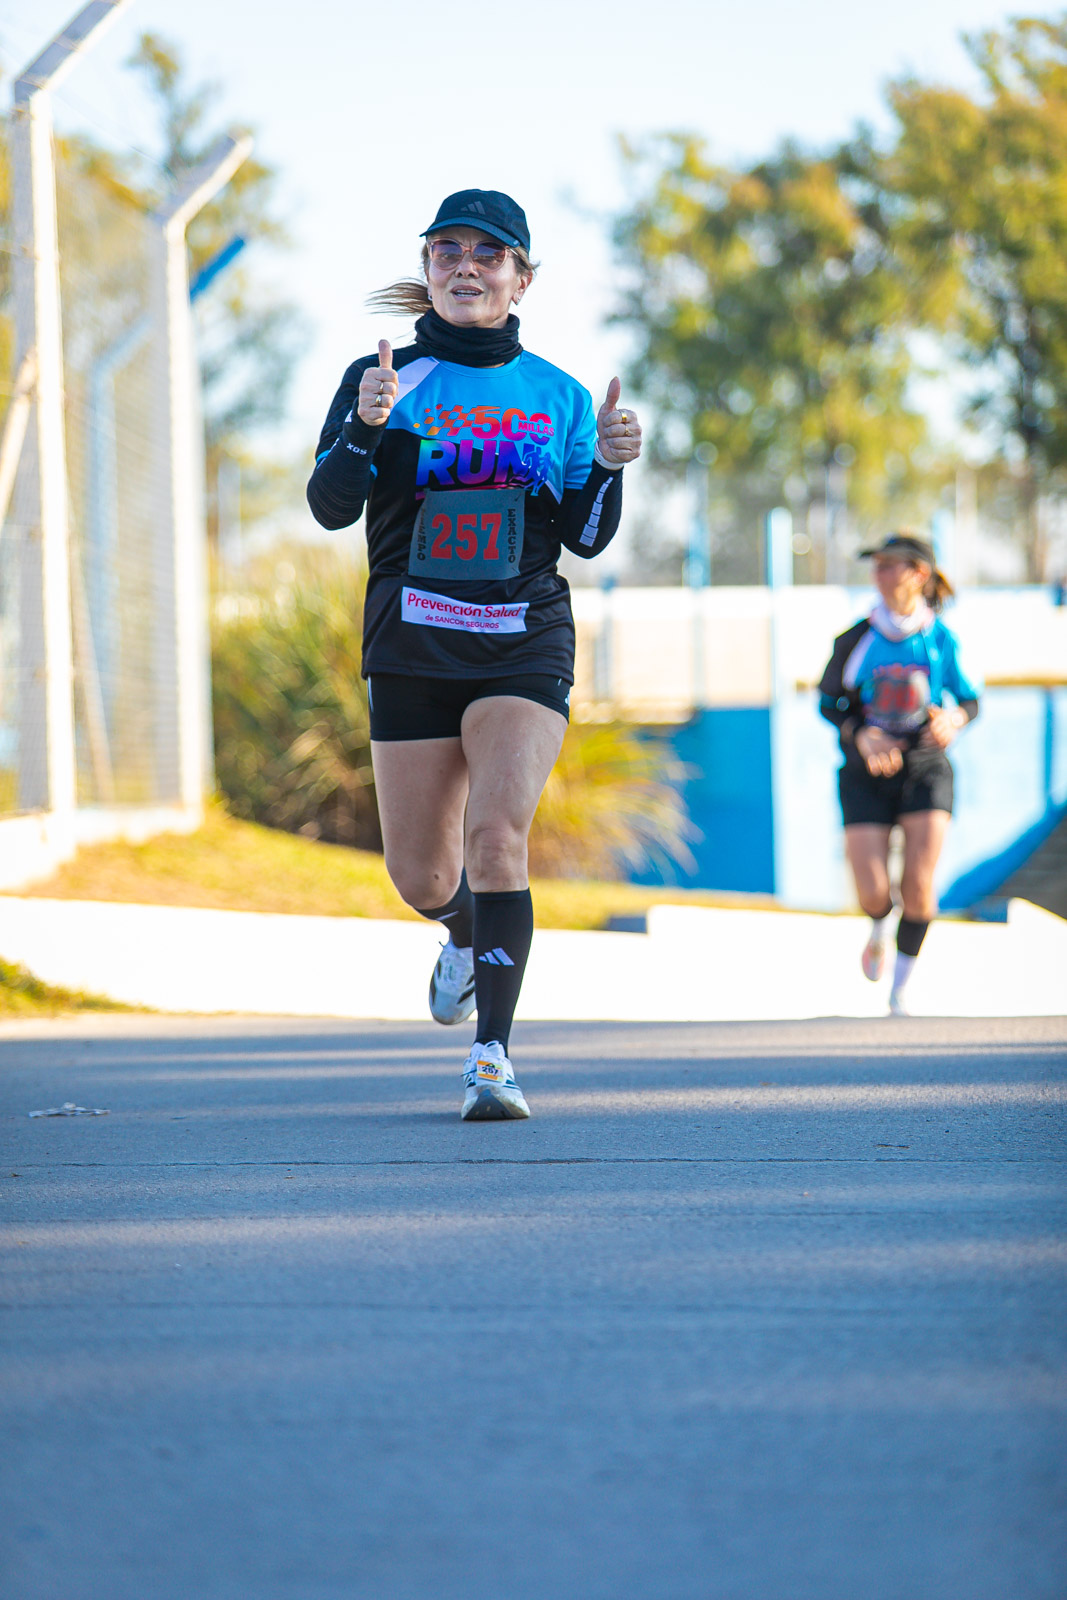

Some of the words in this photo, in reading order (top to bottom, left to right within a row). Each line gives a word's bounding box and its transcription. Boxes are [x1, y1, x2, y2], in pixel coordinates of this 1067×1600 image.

[518, 421, 555, 437] MILLAS
[416, 439, 536, 486] RUN
[430, 513, 502, 560] 257
[507, 509, 517, 563] EXACTO
[407, 592, 482, 617] Prevención
[483, 605, 522, 618] Salud
[434, 616, 465, 626] SANCOR
[466, 620, 500, 629] SEGUROS
